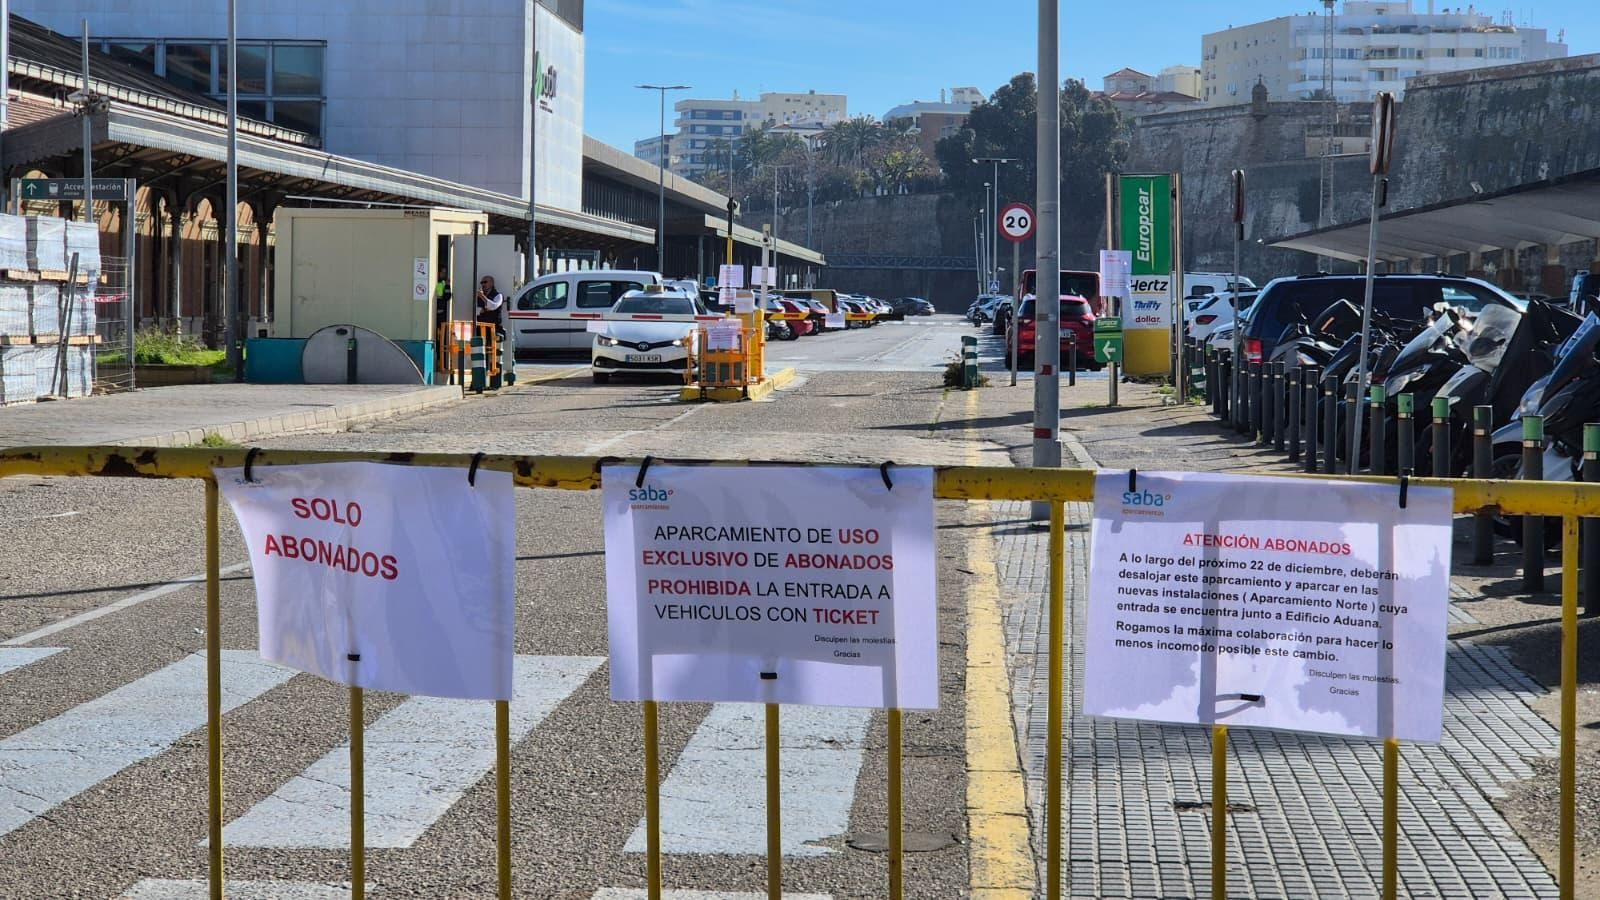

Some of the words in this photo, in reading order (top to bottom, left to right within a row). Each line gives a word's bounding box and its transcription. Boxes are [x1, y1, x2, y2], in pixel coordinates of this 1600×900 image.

[1006, 216, 1029, 229] 20
[1136, 188, 1153, 262] Europcar
[291, 497, 362, 527] SOLO
[654, 525, 802, 543] APARCAMIENTO
[807, 528, 832, 544] DE
[838, 528, 880, 545] USO
[1183, 533, 1259, 549] ATENCIÓN
[1264, 537, 1353, 556] ABONADOS
[264, 534, 399, 581] ABONADOS
[642, 550, 749, 567] EXCLUSIVO
[753, 552, 779, 568] DE
[784, 553, 894, 570] ABONADOS
[1119, 553, 1128, 563] A
[1131, 553, 1142, 563] lo
[1145, 554, 1175, 567] largo
[1178, 556, 1195, 567] del
[1199, 559, 1247, 570] próximo
[1250, 560, 1264, 571] 22
[1267, 562, 1282, 572] de
[1285, 563, 1347, 577] diciembre,
[1350, 568, 1399, 581] deberán
[648, 579, 752, 597] PROHIBIDA
[756, 581, 779, 597] LA
[784, 582, 873, 600] ENTRADA
[878, 584, 891, 600] A
[1118, 569, 1171, 583] desalojar
[1174, 573, 1199, 583] este
[1202, 575, 1282, 589] aparcamiento
[1285, 581, 1292, 590] y
[1295, 581, 1340, 592] aparcar
[1343, 585, 1358, 594] en
[1361, 584, 1379, 595] las
[1117, 586, 1159, 597] nuevas
[1162, 587, 1239, 601] instalaciones
[1250, 592, 1332, 608] Aparcamiento
[1335, 599, 1368, 611] Norte
[1379, 604, 1408, 616] cuya
[654, 604, 762, 622] VEHICULOS
[767, 606, 807, 623] CON
[812, 608, 880, 625] TICKET
[1117, 602, 1160, 613] entrada
[1163, 605, 1177, 614] se
[1180, 606, 1239, 618] encuentra
[1241, 608, 1272, 620] junto
[1275, 612, 1282, 620] a
[1286, 611, 1330, 624] Edificio
[1333, 615, 1383, 629] Aduana.
[849, 635, 861, 644] las
[1116, 620, 1170, 634] Rogamos
[1173, 625, 1184, 635] la
[1187, 626, 1233, 638] máxima
[1236, 628, 1313, 643] colaboración
[1316, 635, 1342, 646] para
[1345, 636, 1379, 649] hacer
[1382, 639, 1394, 650] lo
[833, 649, 862, 658] Gracias
[1115, 638, 1154, 649] menos
[1156, 639, 1215, 653] incomodo
[1218, 644, 1261, 656] posible
[1264, 647, 1289, 656] este
[1292, 648, 1339, 662] cambio.
[1309, 669, 1347, 681] Disculpen
[1349, 672, 1361, 681] las
[1329, 686, 1360, 697] Gracias
